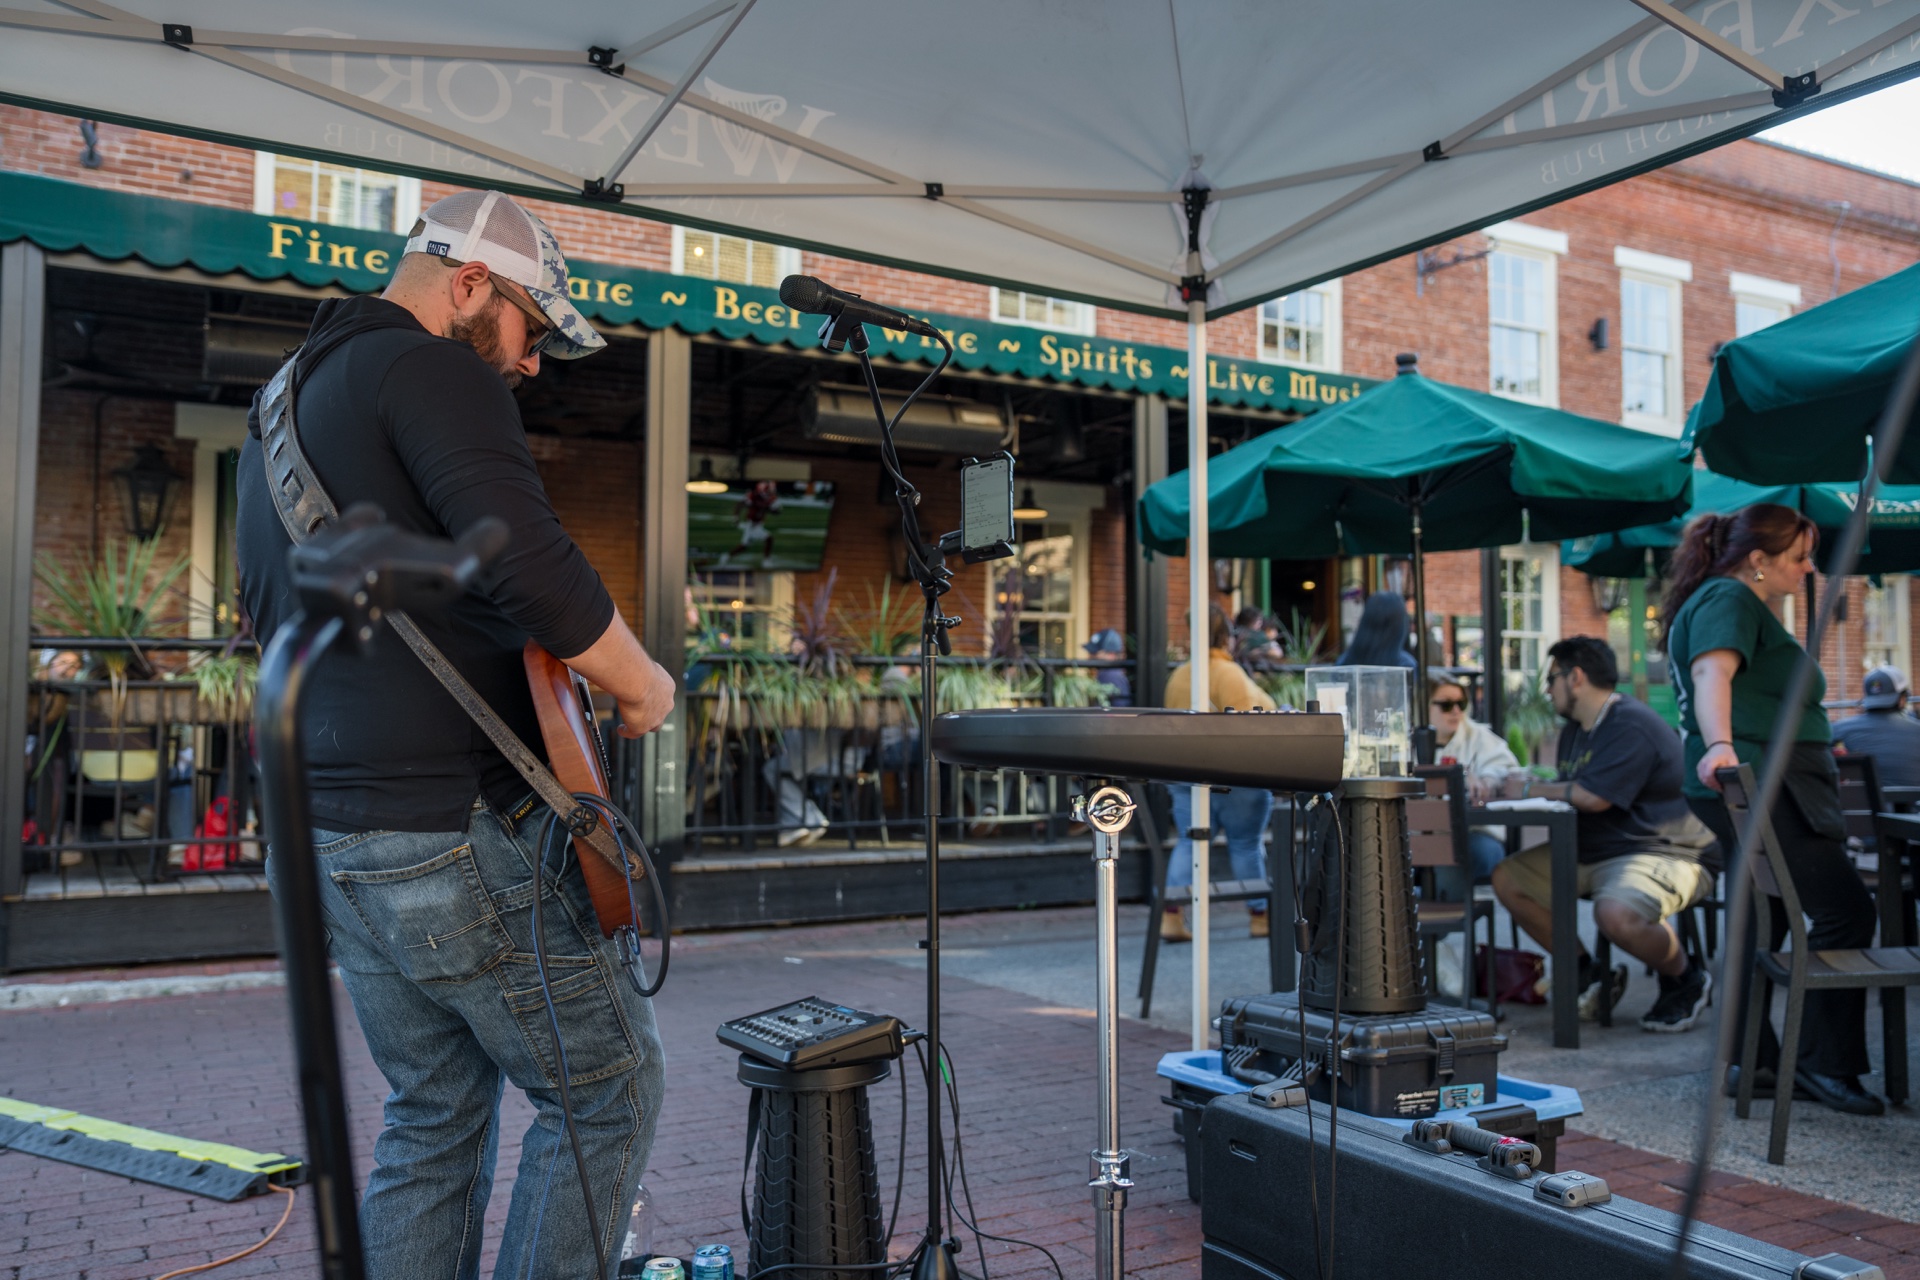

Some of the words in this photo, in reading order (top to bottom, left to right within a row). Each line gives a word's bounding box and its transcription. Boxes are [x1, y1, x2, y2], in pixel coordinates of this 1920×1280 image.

[267, 222, 390, 275] Fine
[567, 273, 633, 306] are
[1039, 335, 1153, 381] Spirits
[1208, 360, 1275, 396] Live
[1289, 371, 1361, 404] Musi
[1837, 491, 1920, 514] WEX
[515, 800, 533, 820] ARIAT
